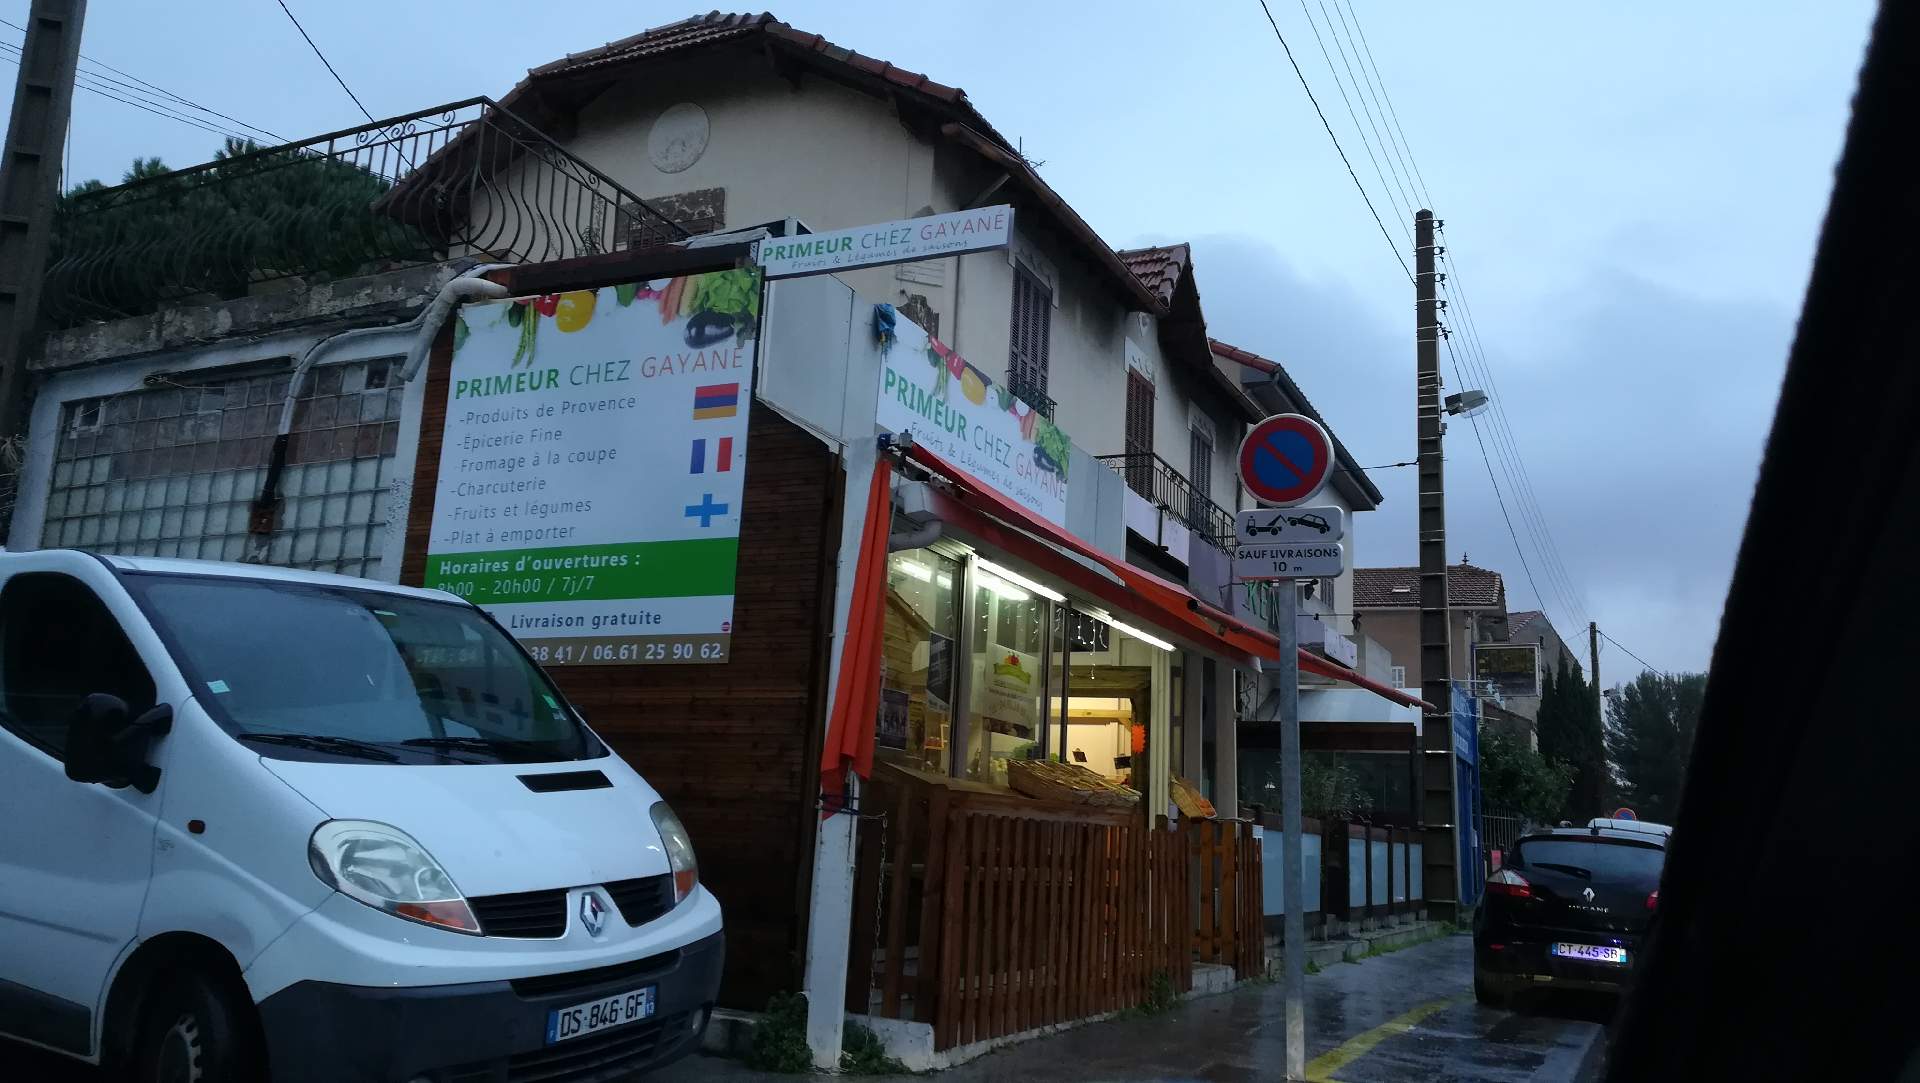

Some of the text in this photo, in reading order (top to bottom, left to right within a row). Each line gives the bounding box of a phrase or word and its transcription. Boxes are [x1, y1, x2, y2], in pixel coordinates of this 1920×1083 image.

[763, 237, 853, 261] PRIMEUR
[861, 227, 912, 249] CHEZ
[832, 256, 841, 265] &
[455, 368, 560, 400] PRIMEUR
[569, 360, 631, 386] CHEZ
[459, 395, 636, 424] -Produits de Provence
[884, 366, 967, 442] PRIMEUR
[974, 425, 1011, 468] CHEZ
[530, 428, 563, 443] Fine
[532, 452, 540, 467] à
[548, 450, 560, 465] la
[568, 448, 617, 464] coupe
[450, 478, 546, 498] -Charcuterie
[448, 499, 592, 521] -Fruits et légumes
[485, 528, 494, 543] à
[500, 525, 576, 546] emporter
[1239, 548, 1339, 559] SAUF LIVRAISONS
[440, 559, 509, 576] Horaires
[1273, 562, 1287, 572] 10
[493, 577, 542, 595] 20h00
[547, 577, 555, 595] /
[562, 575, 595, 596] 7j/7
[511, 611, 662, 633] Livraison gratuite
[554, 646, 572, 660] 41
[579, 645, 587, 662] /
[592, 645, 613, 660] 06
[619, 644, 637, 659] 61
[645, 644, 666, 659] 25
[672, 643, 693, 659] 90
[700, 643, 721, 659] 62
